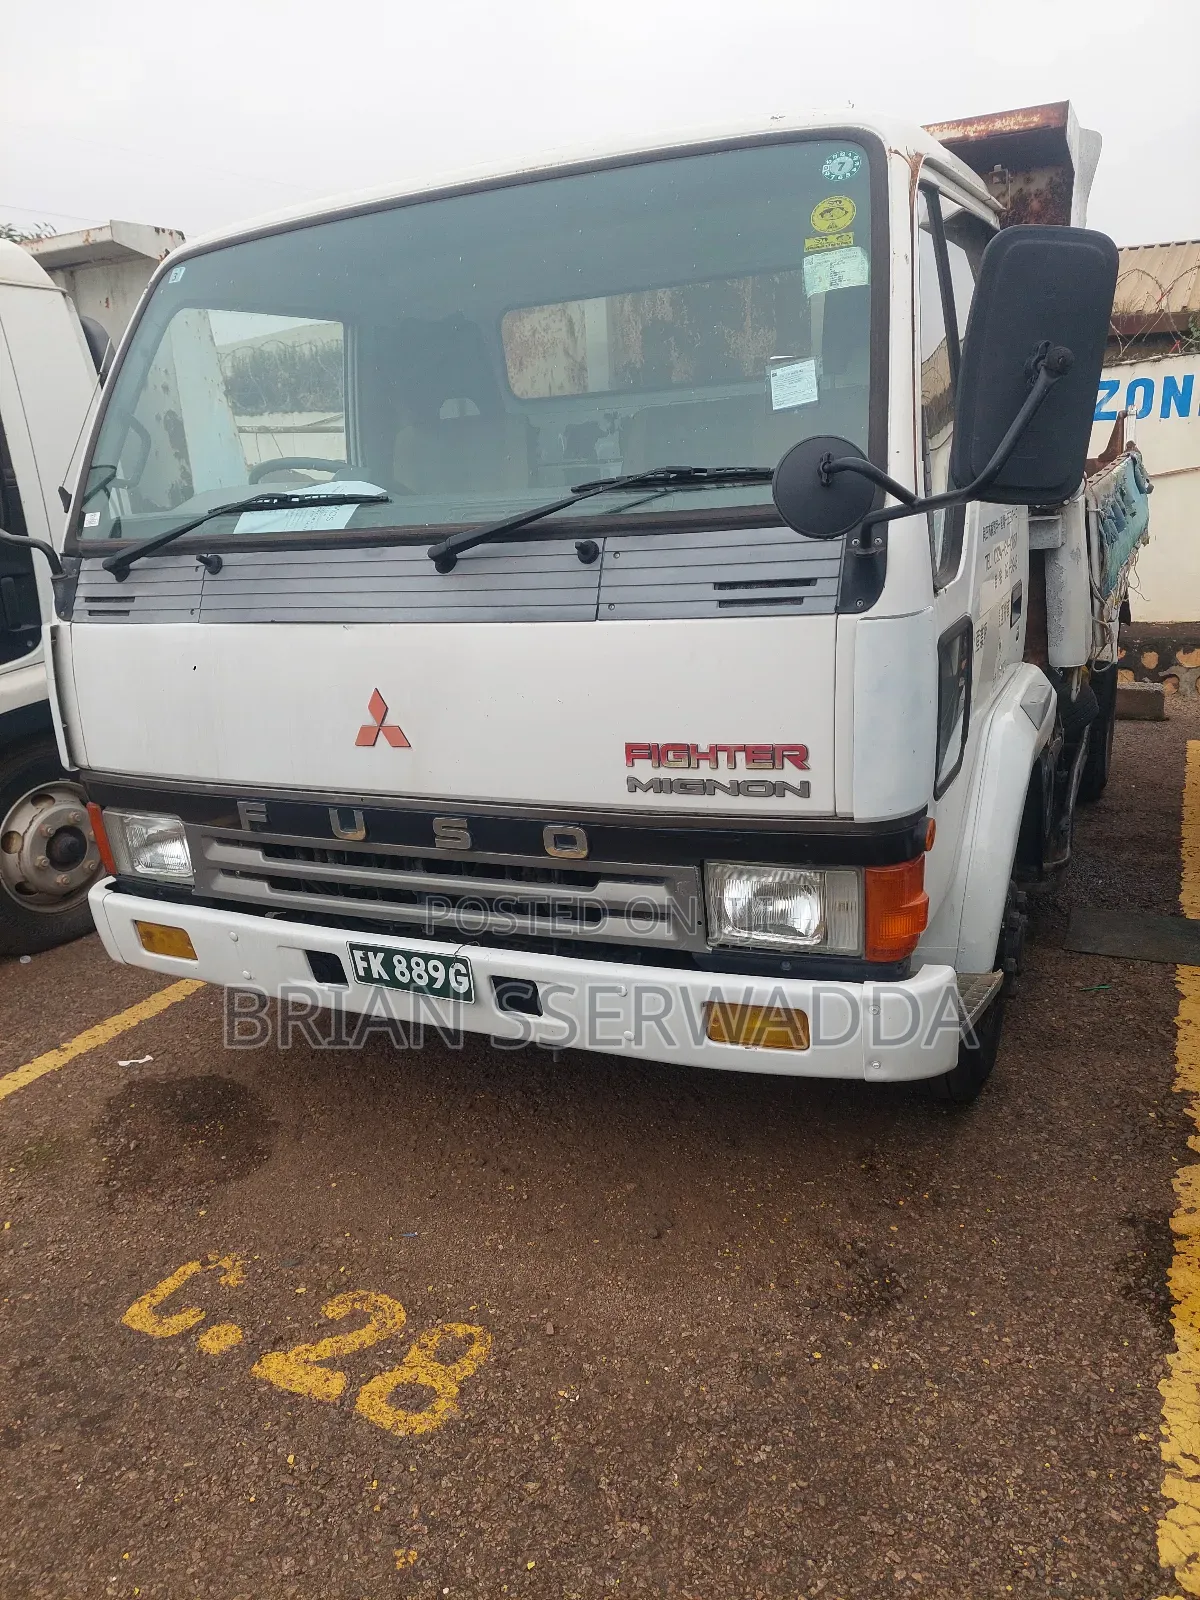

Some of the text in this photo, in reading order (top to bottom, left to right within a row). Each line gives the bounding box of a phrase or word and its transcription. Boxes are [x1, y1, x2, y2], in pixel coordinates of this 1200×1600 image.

[1093, 374, 1200, 421] ZON
[624, 742, 811, 771] FIGHTER
[626, 776, 811, 799] MIGNON
[236, 801, 590, 860] FUSO
[352, 949, 391, 981] FK
